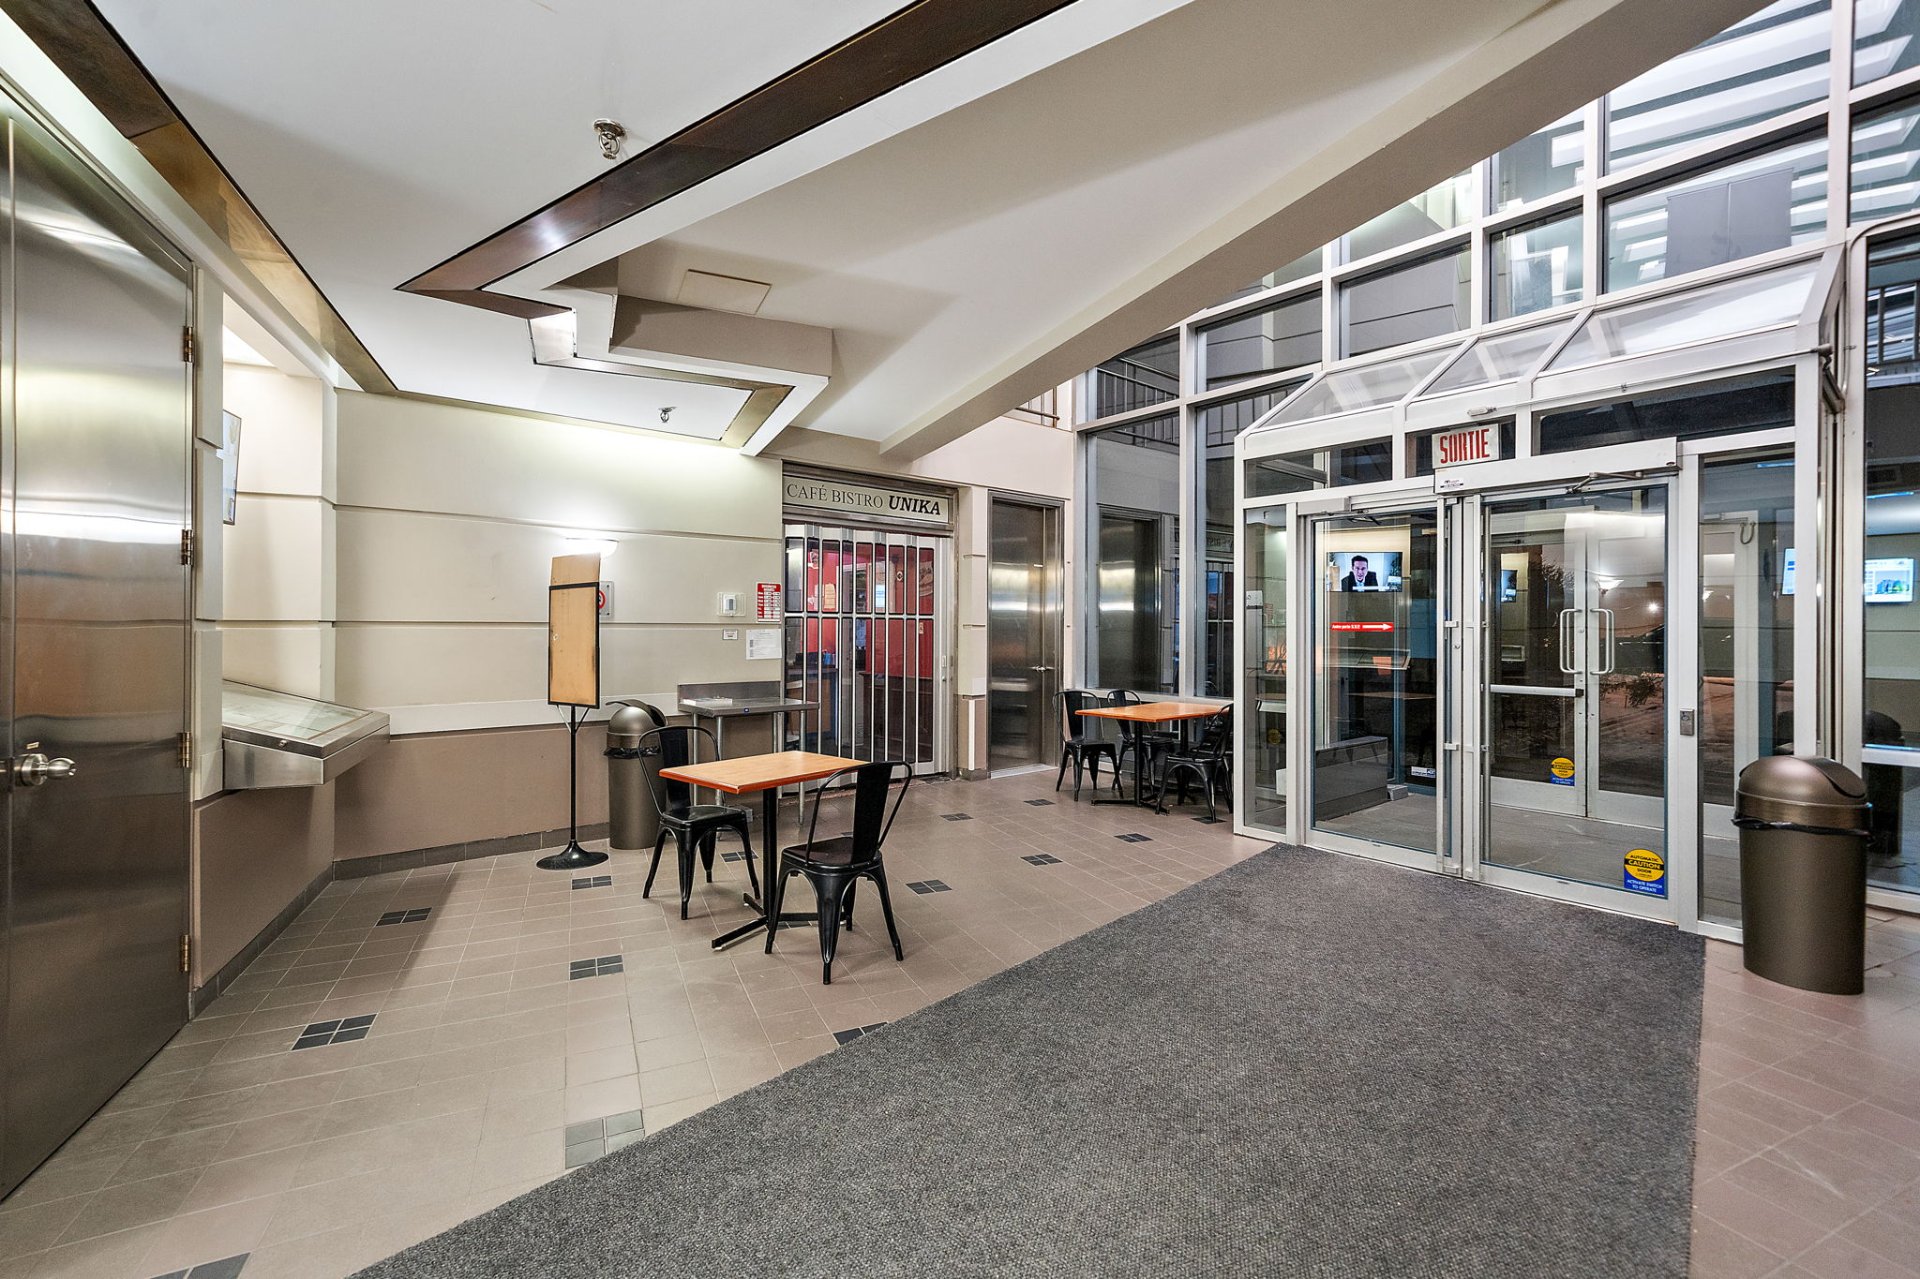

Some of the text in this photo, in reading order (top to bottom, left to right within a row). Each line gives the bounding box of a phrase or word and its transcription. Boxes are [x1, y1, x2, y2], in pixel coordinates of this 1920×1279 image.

[1440, 428, 1490, 464] SORTIE
[787, 483, 941, 516] CAFÉ BISTRO UNIKA
[1628, 859, 1660, 869] CAUTION
